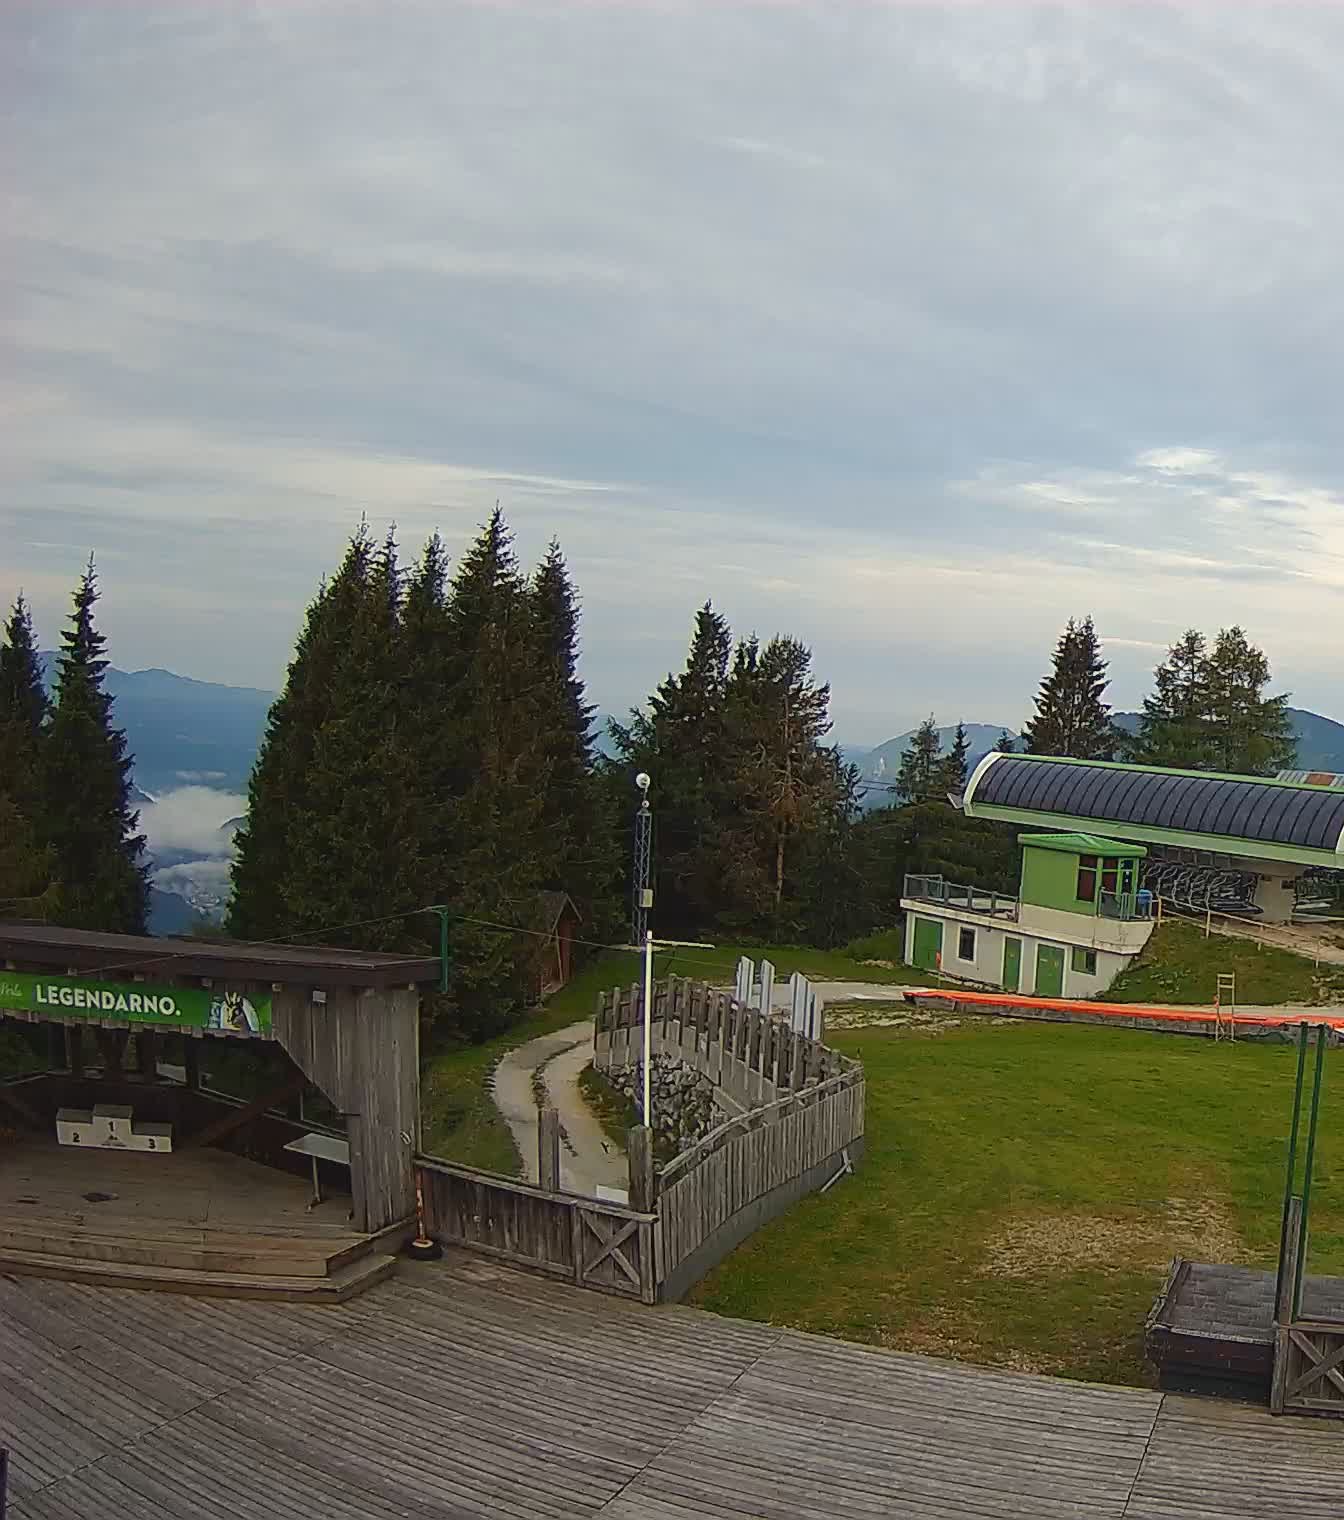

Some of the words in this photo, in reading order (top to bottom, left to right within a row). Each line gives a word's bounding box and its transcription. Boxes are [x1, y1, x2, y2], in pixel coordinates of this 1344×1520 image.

[36, 984, 182, 1017] LEGENDARNO.
[107, 1120, 115, 1133] 1
[72, 1132, 81, 1143] 2
[148, 1138, 156, 1150] 3
